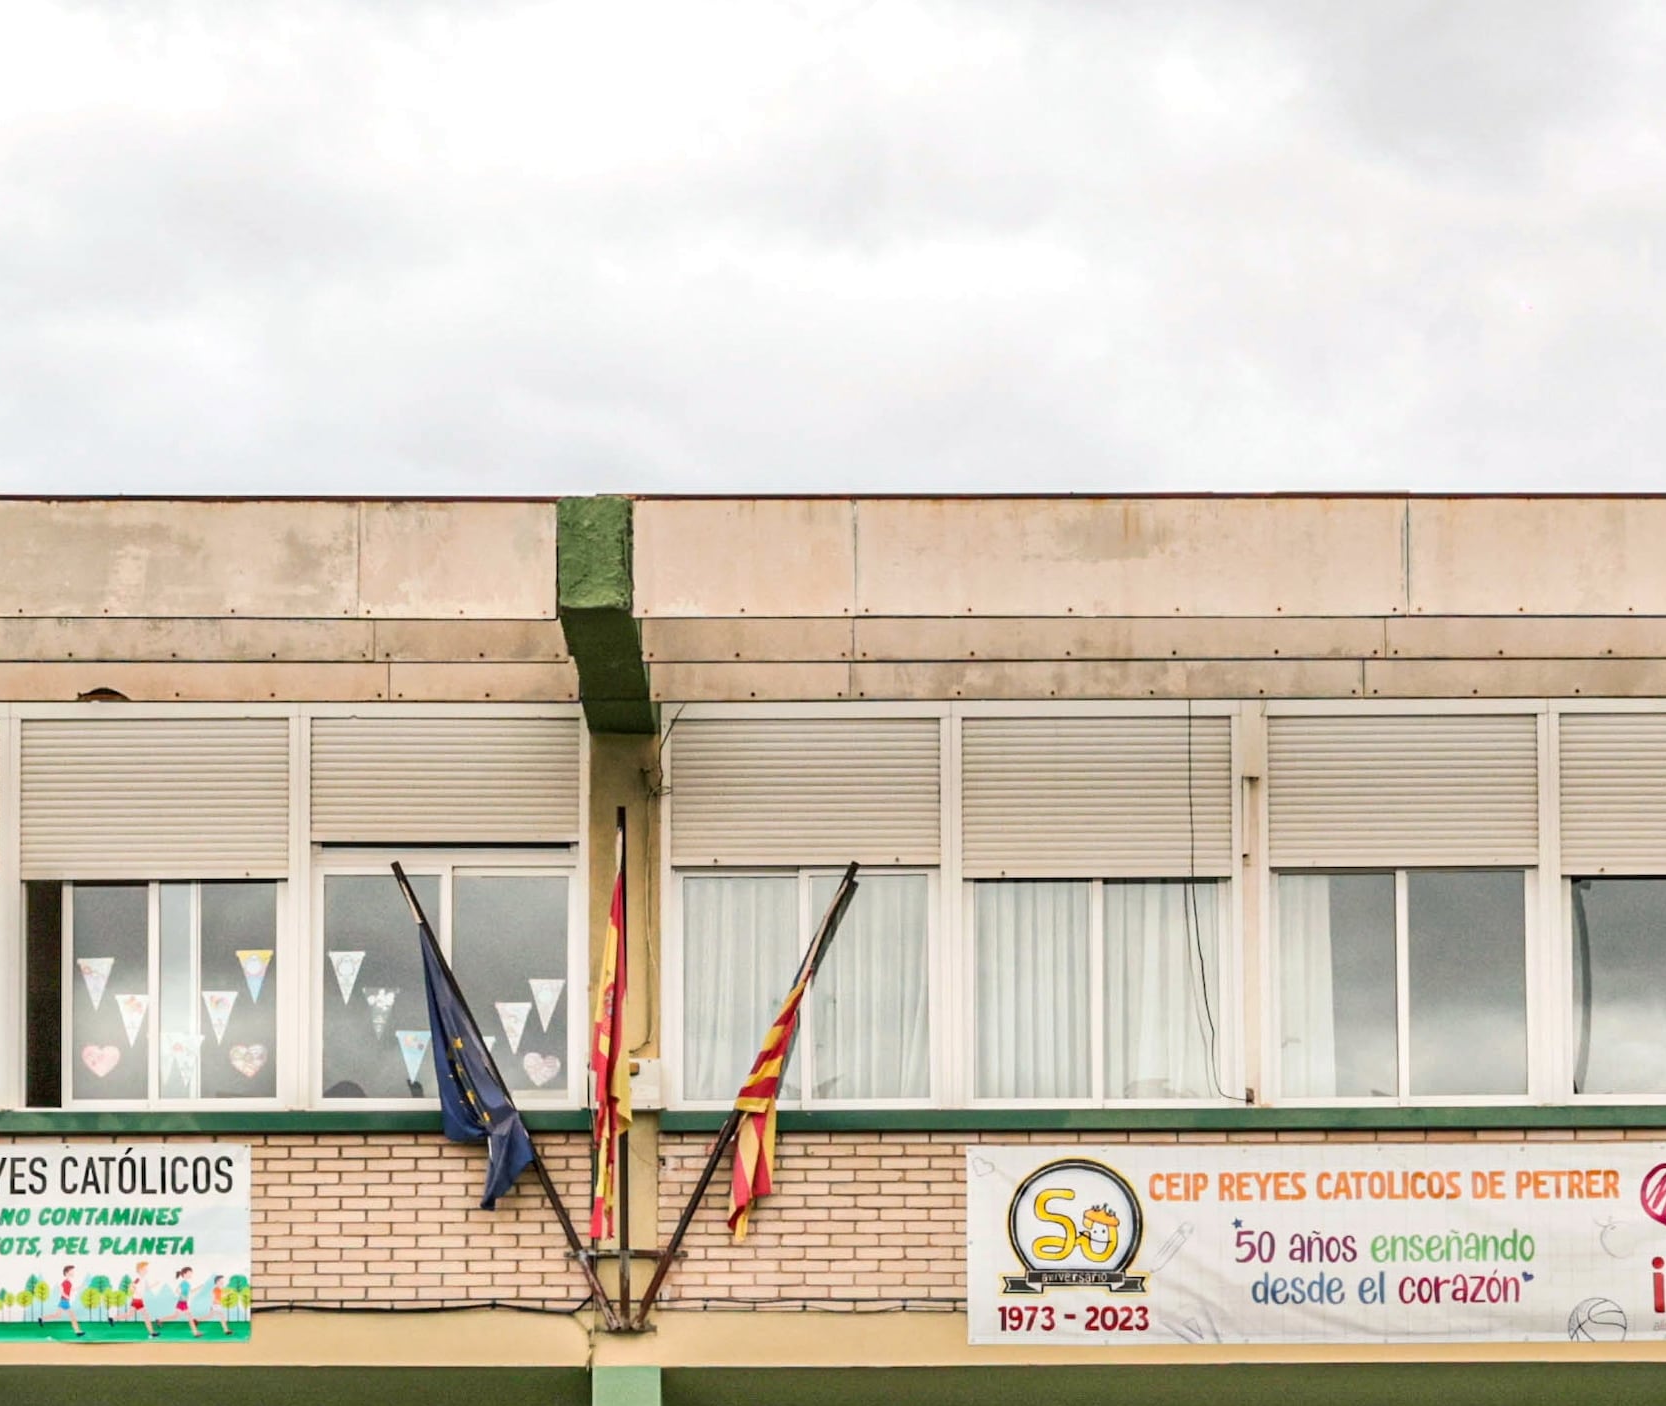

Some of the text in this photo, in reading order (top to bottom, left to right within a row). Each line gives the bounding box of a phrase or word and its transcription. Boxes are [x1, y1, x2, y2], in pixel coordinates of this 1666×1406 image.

[60, 1147, 234, 1195] CATÓLICOS
[1148, 1169, 1620, 1201] CEIP REYES CATOLICOS DE PETRER
[38, 1207, 183, 1226] CONTAMINES
[51, 1236, 90, 1255] PEL
[98, 1236, 195, 1255] PLANETA
[1235, 1228, 1535, 1263] 50 años enseñando
[1042, 1273, 1108, 1283] aniversario
[1252, 1269, 1521, 1305] desde el corazón
[998, 1306, 1056, 1331] 1973
[1084, 1306, 1150, 1332] 2023
